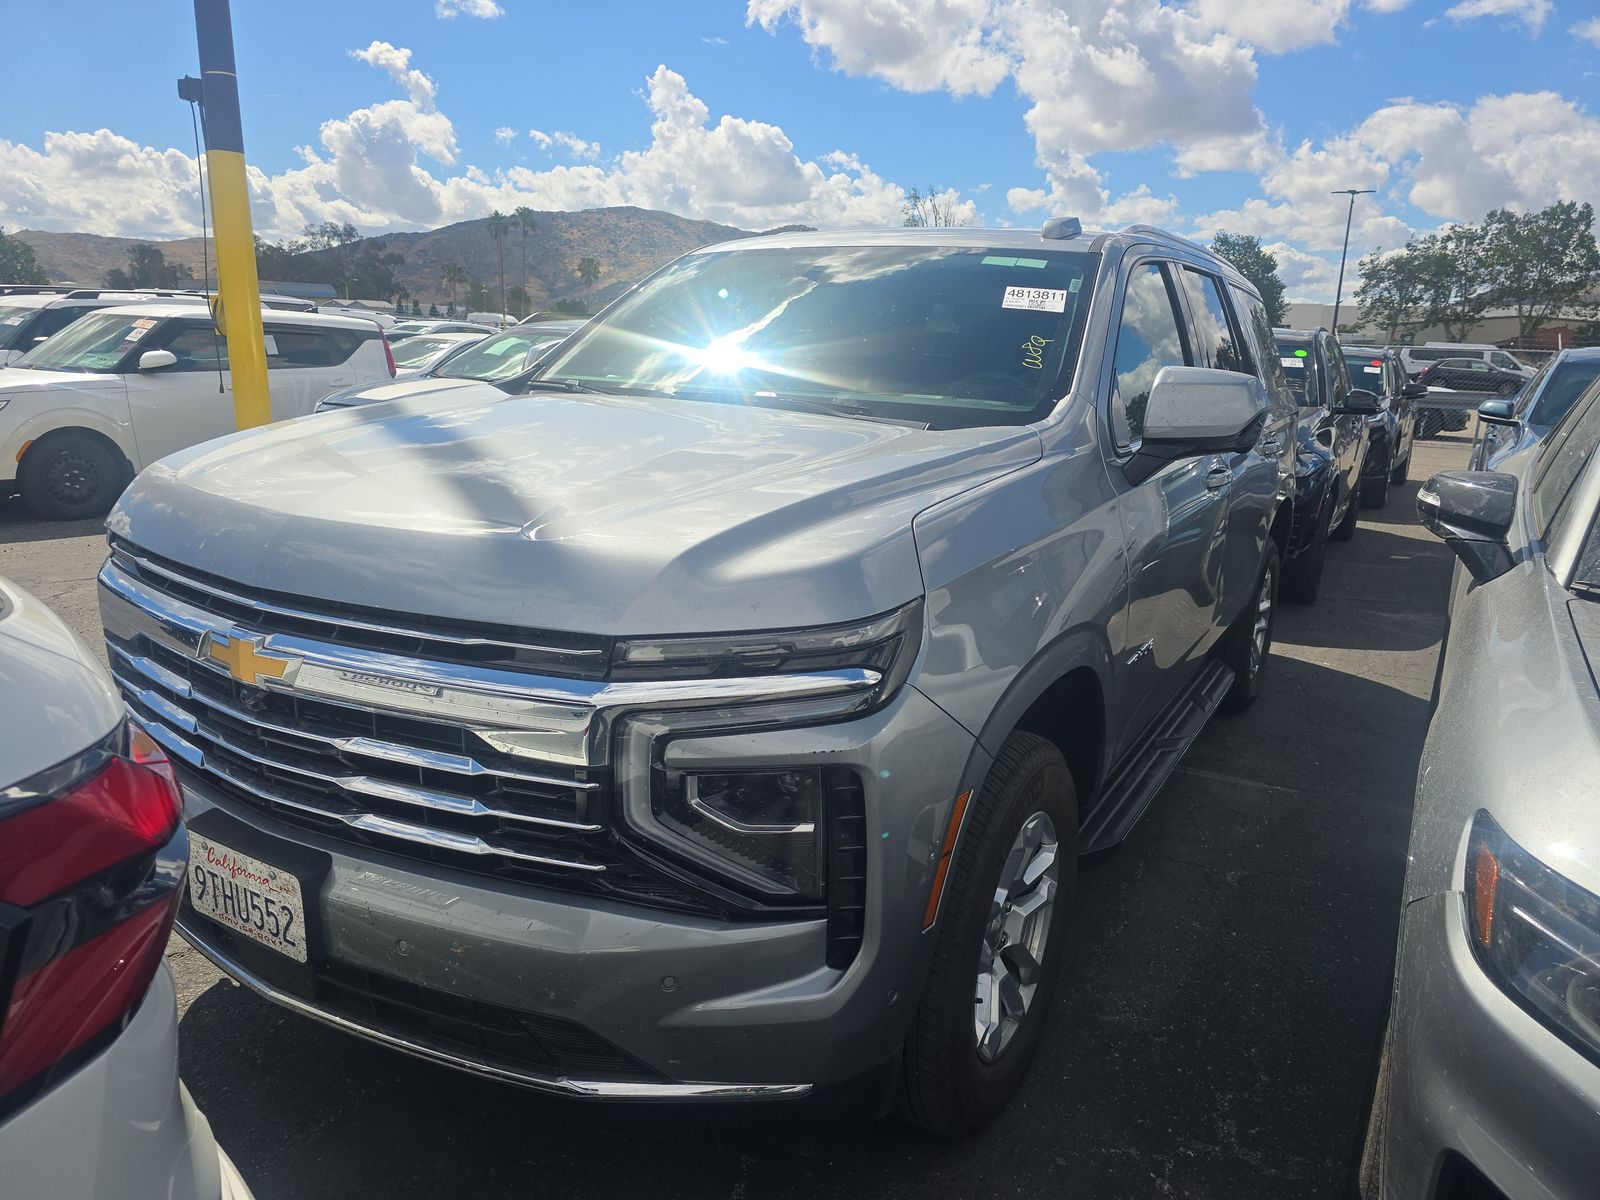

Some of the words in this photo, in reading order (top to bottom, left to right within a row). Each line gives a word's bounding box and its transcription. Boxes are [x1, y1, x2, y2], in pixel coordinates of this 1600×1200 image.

[1007, 289, 1065, 301] 4813811
[207, 847, 280, 893] California
[195, 865, 296, 947] 9THU552
